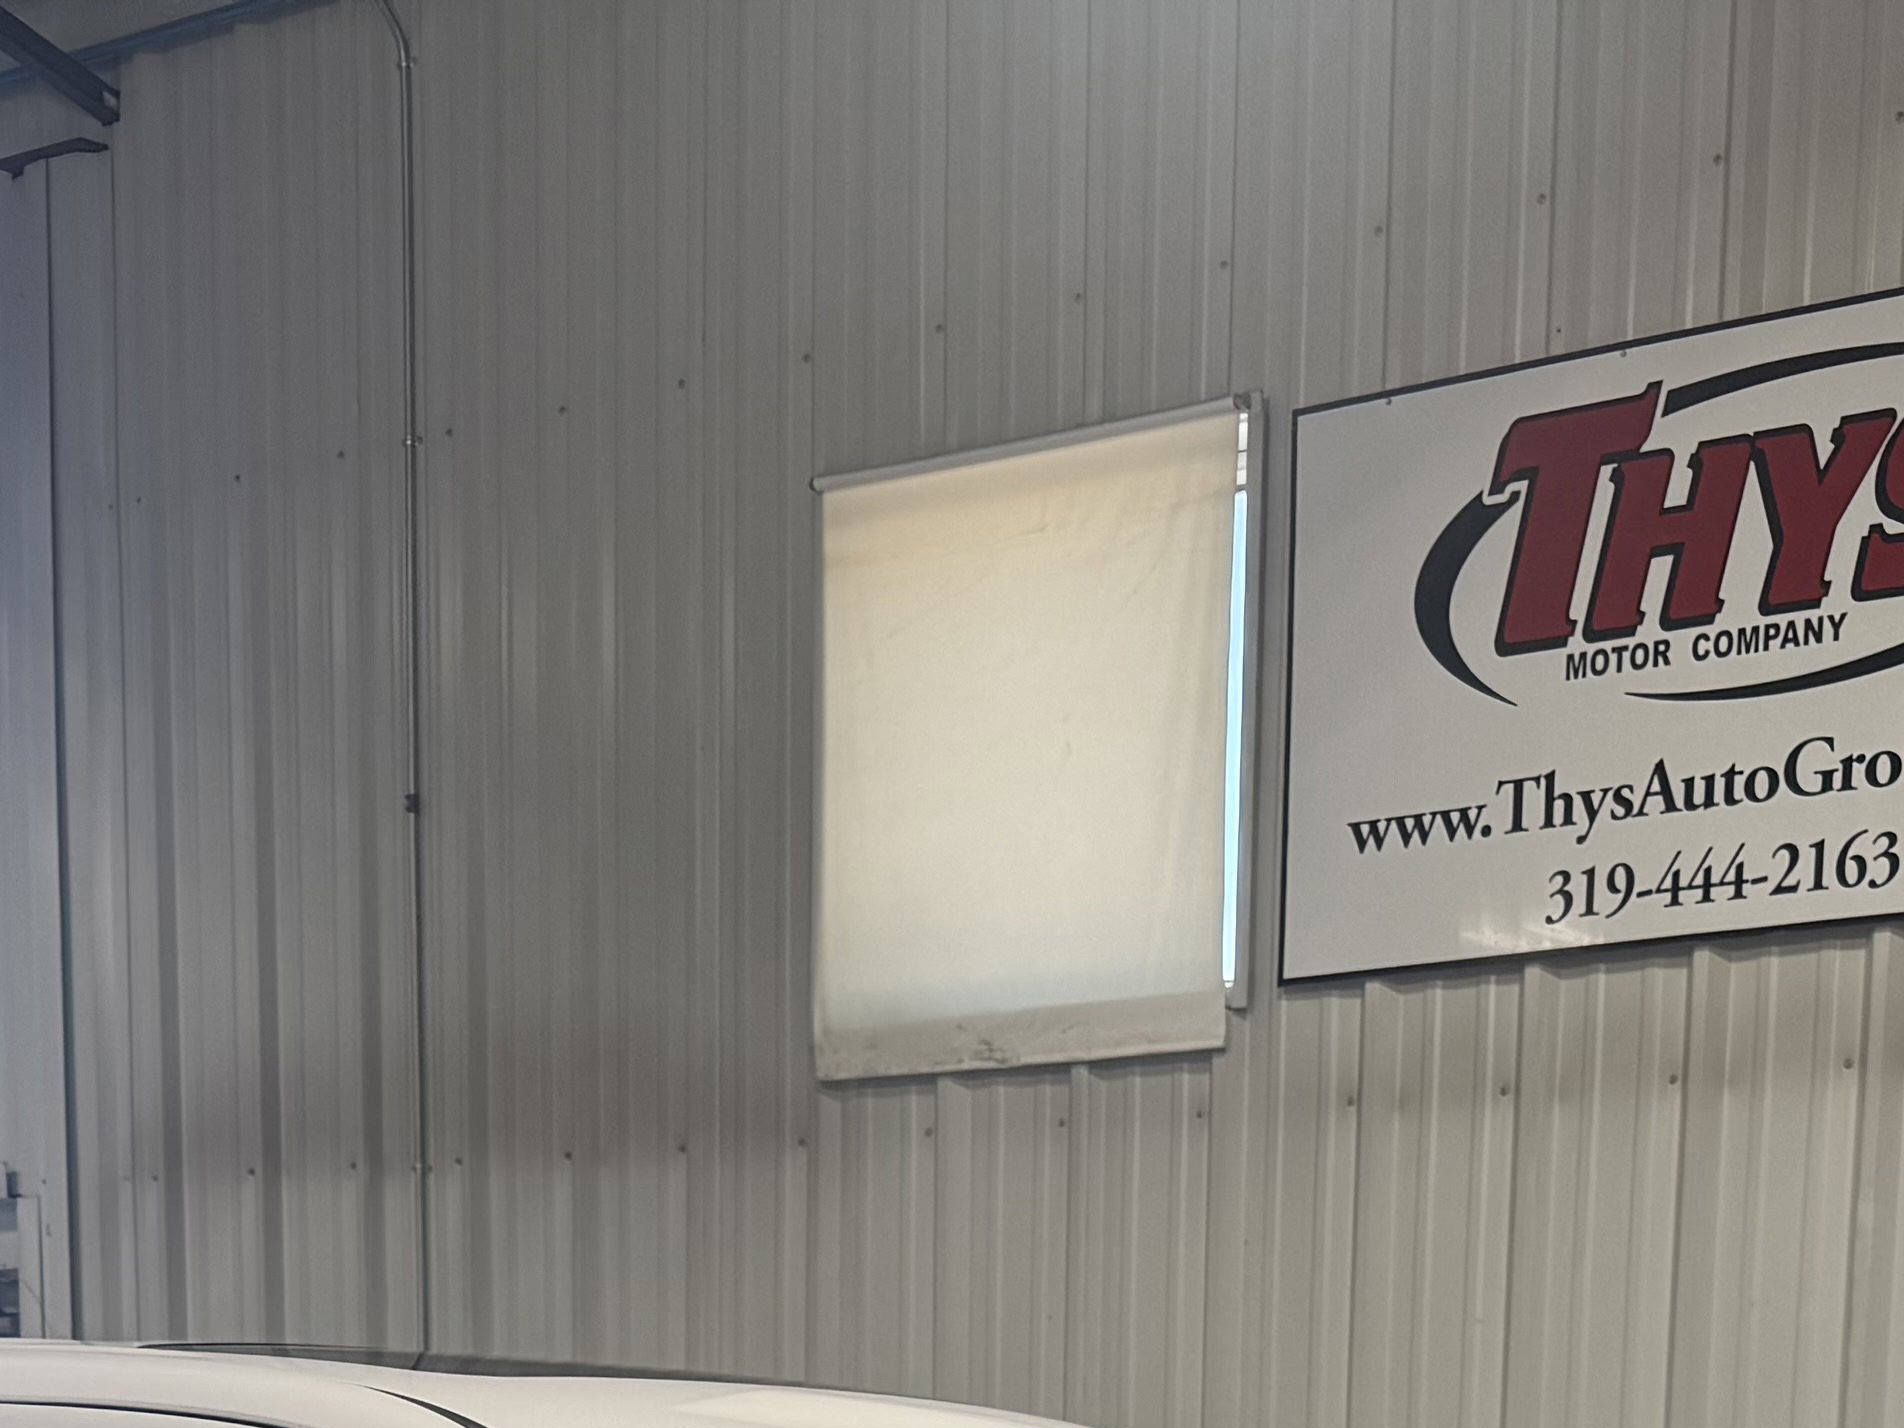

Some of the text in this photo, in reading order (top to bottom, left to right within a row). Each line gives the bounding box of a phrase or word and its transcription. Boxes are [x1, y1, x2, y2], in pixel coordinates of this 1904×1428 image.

[1564, 612, 1849, 681] MOTOR COMPANY
[1545, 830, 1901, 924] 319-444-2163
